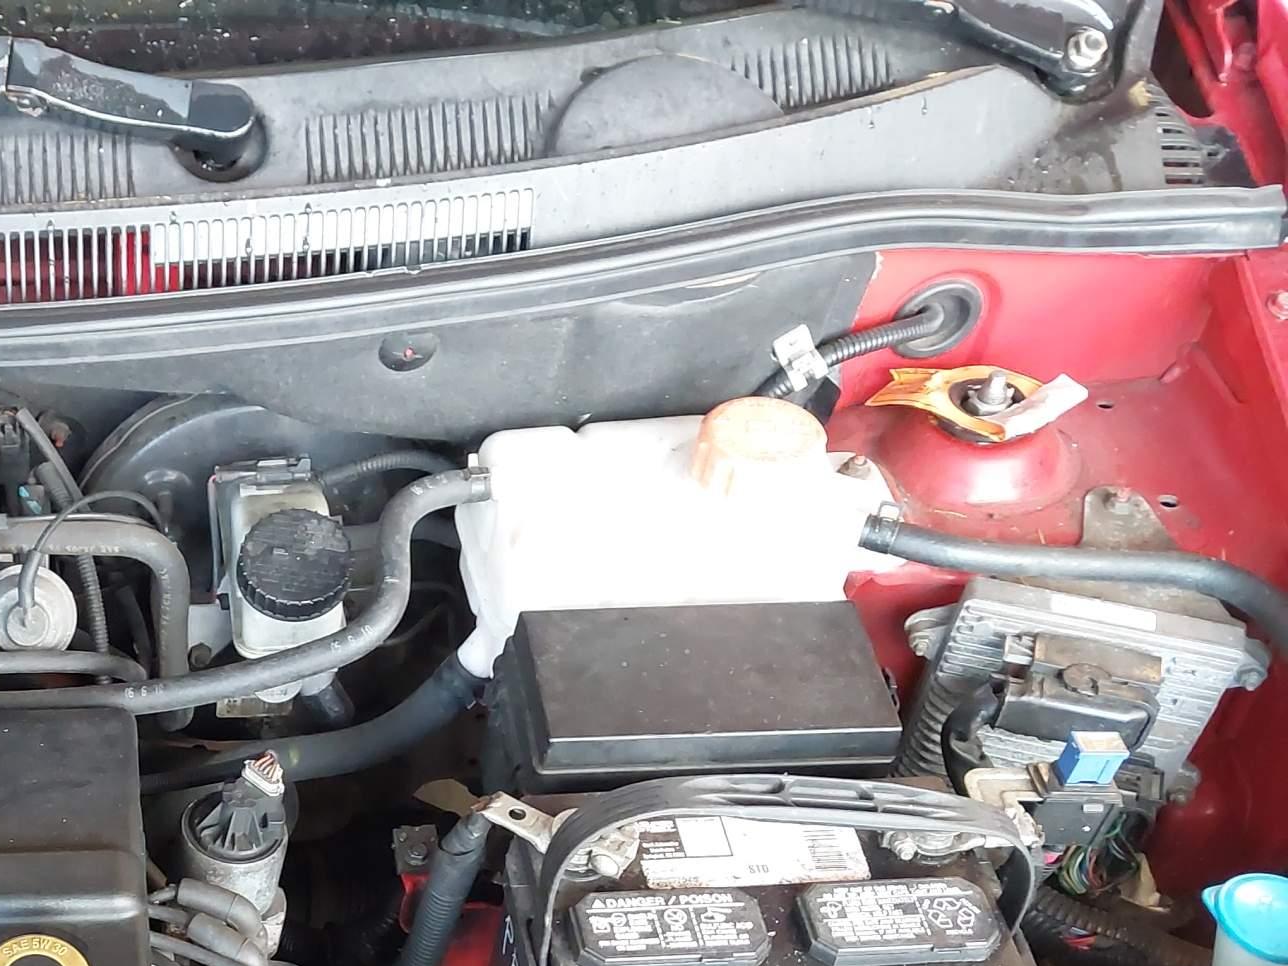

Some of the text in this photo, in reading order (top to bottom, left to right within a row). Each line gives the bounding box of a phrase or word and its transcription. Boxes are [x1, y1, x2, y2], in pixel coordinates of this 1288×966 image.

[606, 896, 665, 908] DANGER
[679, 893, 733, 904] POISON
[2, 938, 68, 957] SAE 5W 30
